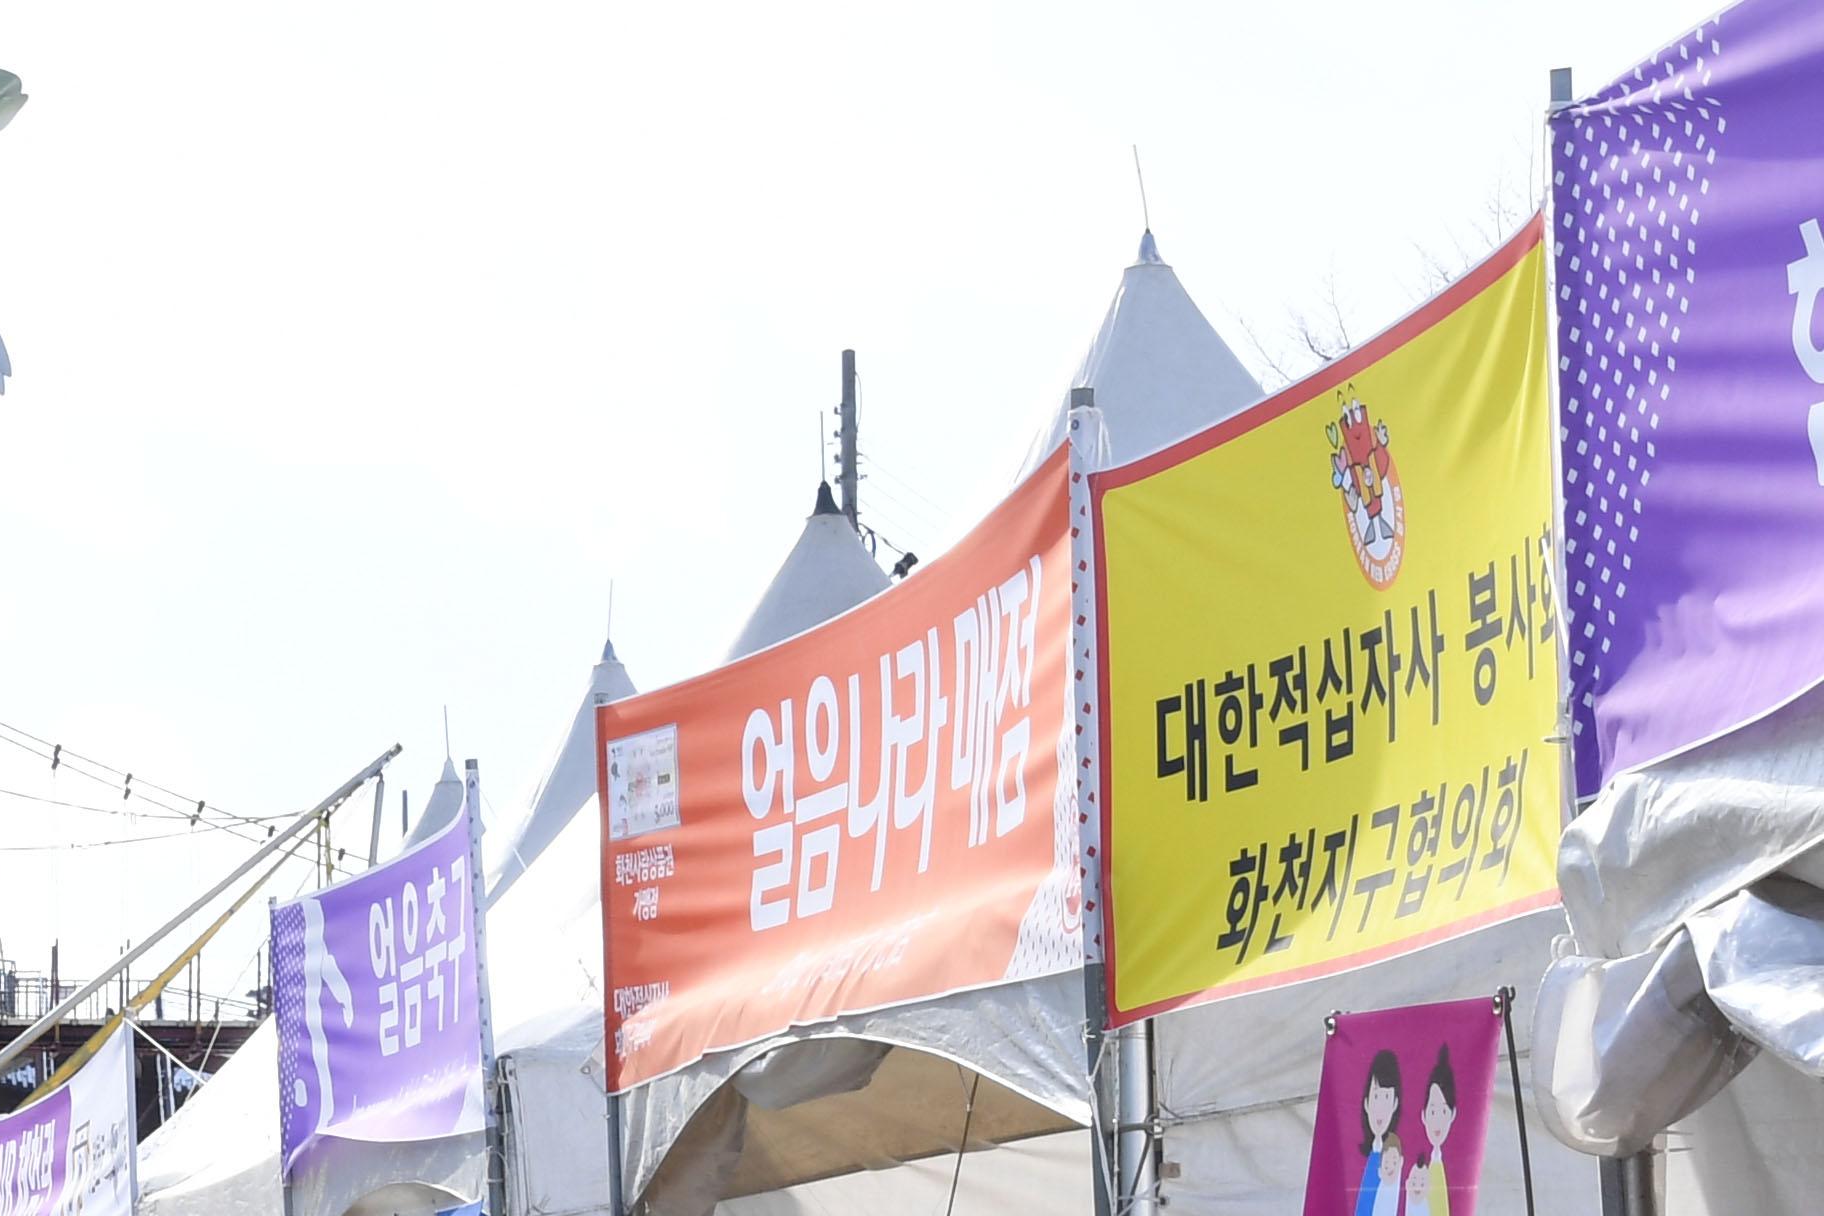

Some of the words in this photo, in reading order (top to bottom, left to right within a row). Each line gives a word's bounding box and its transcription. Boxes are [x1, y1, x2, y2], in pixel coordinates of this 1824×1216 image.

[742, 626, 948, 932] 얼음나라
[950, 554, 1043, 849] 매점
[1156, 589, 1445, 803] 대한적십자사
[369, 855, 466, 1057] 얼음축구
[615, 843, 675, 886] 화천사랑상품권
[1216, 748, 1528, 966] 화천지구협의회
